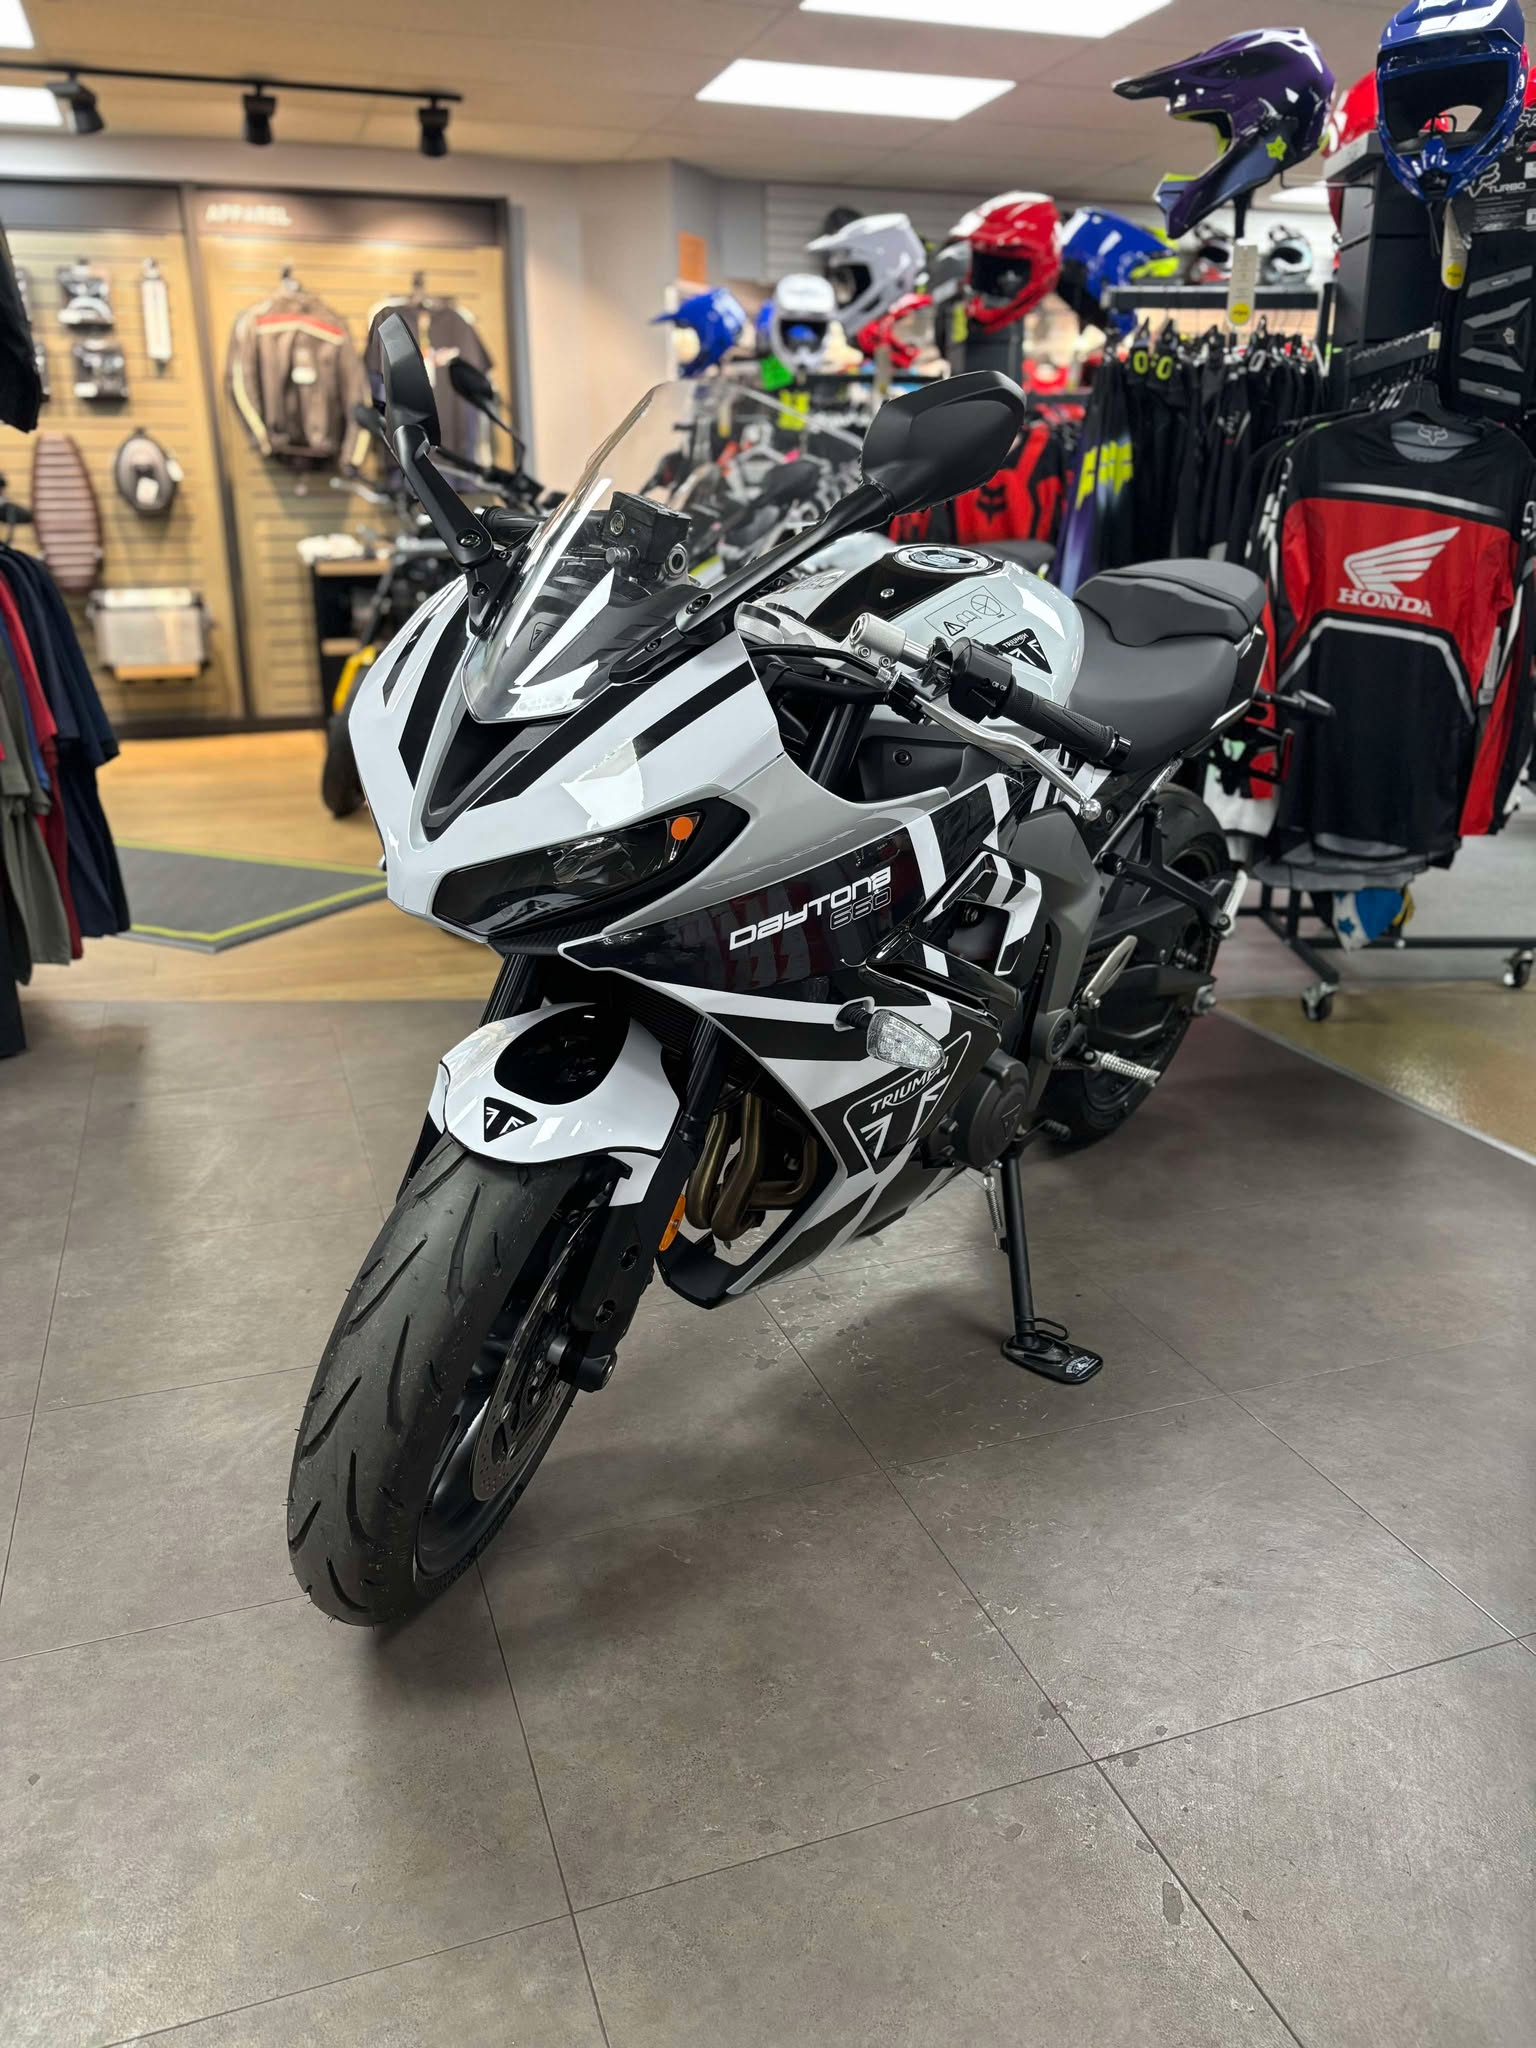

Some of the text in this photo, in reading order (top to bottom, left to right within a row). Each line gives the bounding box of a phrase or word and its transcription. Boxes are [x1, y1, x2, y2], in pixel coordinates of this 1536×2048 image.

[1487, 181, 1527, 194] TURBO
[1337, 586, 1434, 618] HONDA
[1001, 632, 1030, 649] TRIUMPH
[829, 885, 892, 931] 660
